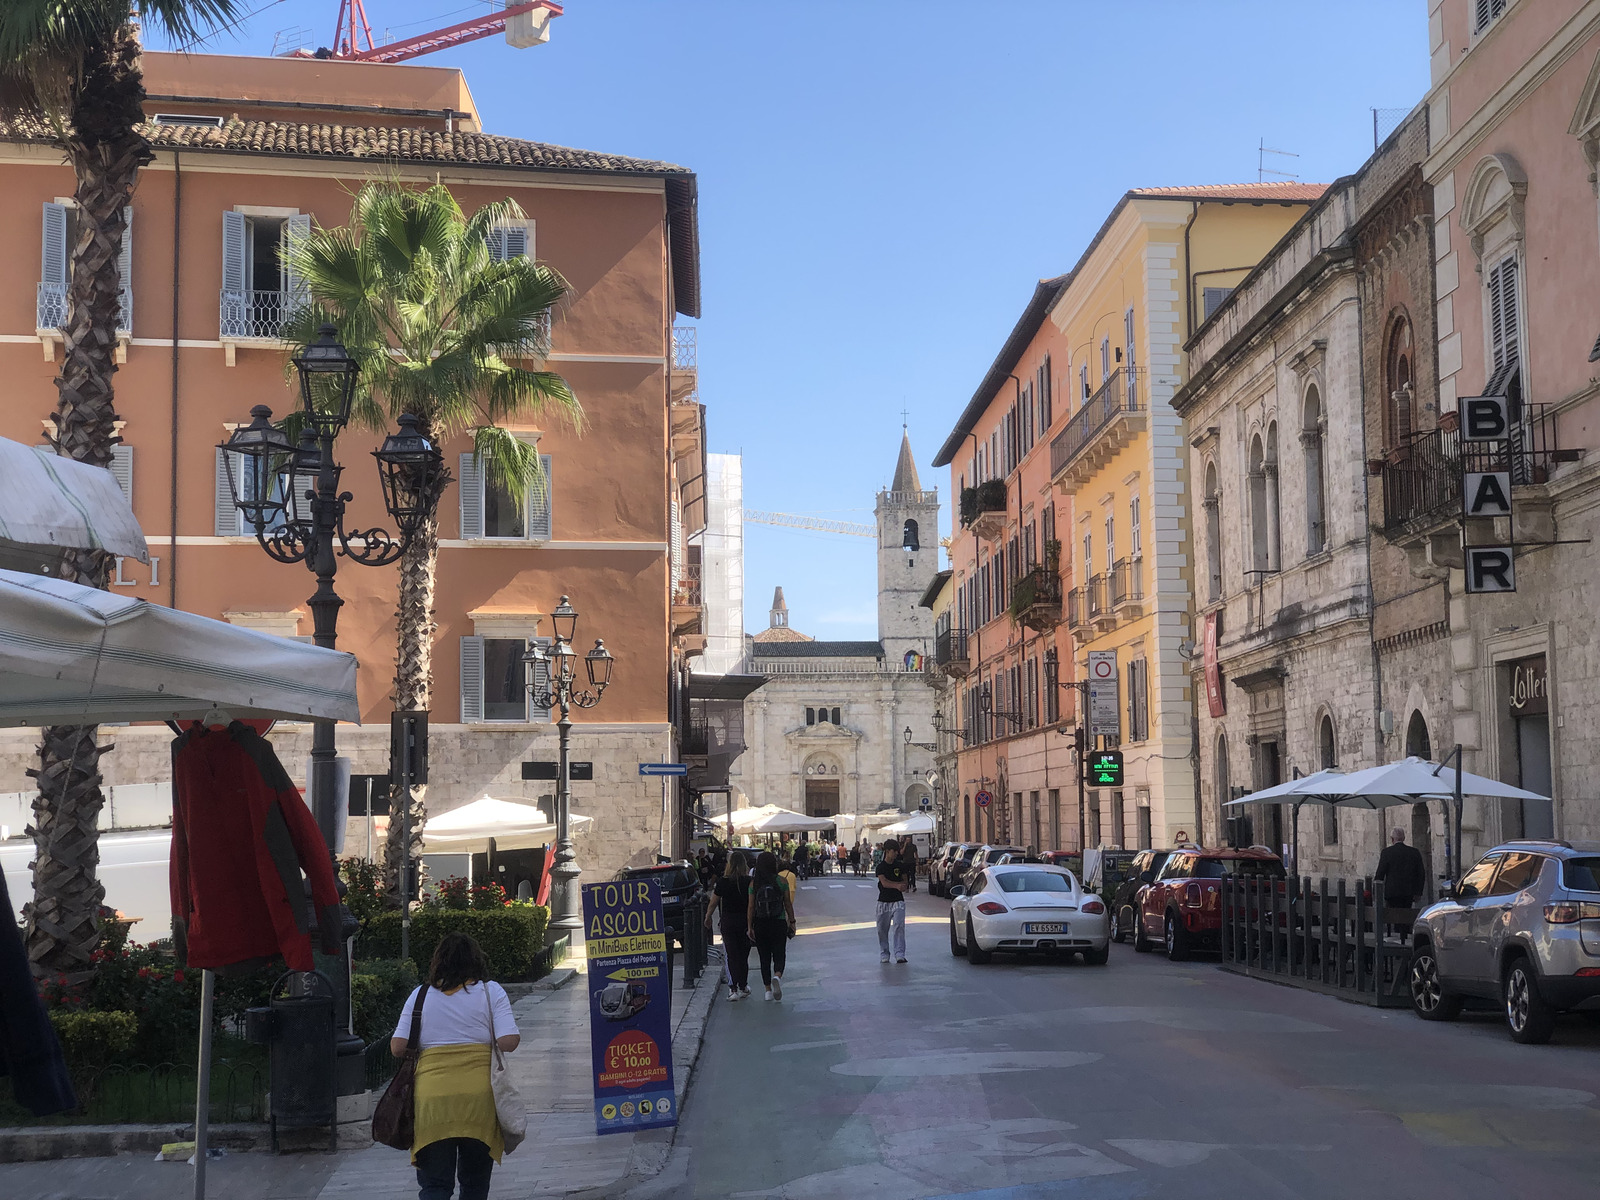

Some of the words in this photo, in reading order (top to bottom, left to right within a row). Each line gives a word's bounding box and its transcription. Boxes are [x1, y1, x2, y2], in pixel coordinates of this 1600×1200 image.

[1467, 399, 1512, 589] BAR
[590, 882, 651, 909] TOUR
[590, 909, 658, 938] ASCOLI
[1030, 924, 1040, 932] EV
[589, 943, 597, 955] in
[597, 939, 629, 954] MiniBus
[629, 937, 662, 951] Elettrico
[596, 958, 617, 967] Partenza
[617, 957, 632, 965] Piazza
[640, 955, 657, 964] Popolo
[626, 969, 642, 977] 100
[609, 1041, 653, 1057] TICKET
[610, 1056, 620, 1069] €
[624, 1056, 651, 1068] 10,00
[600, 1072, 627, 1082] BAMBINI
[643, 1067, 667, 1076] GRATIS
